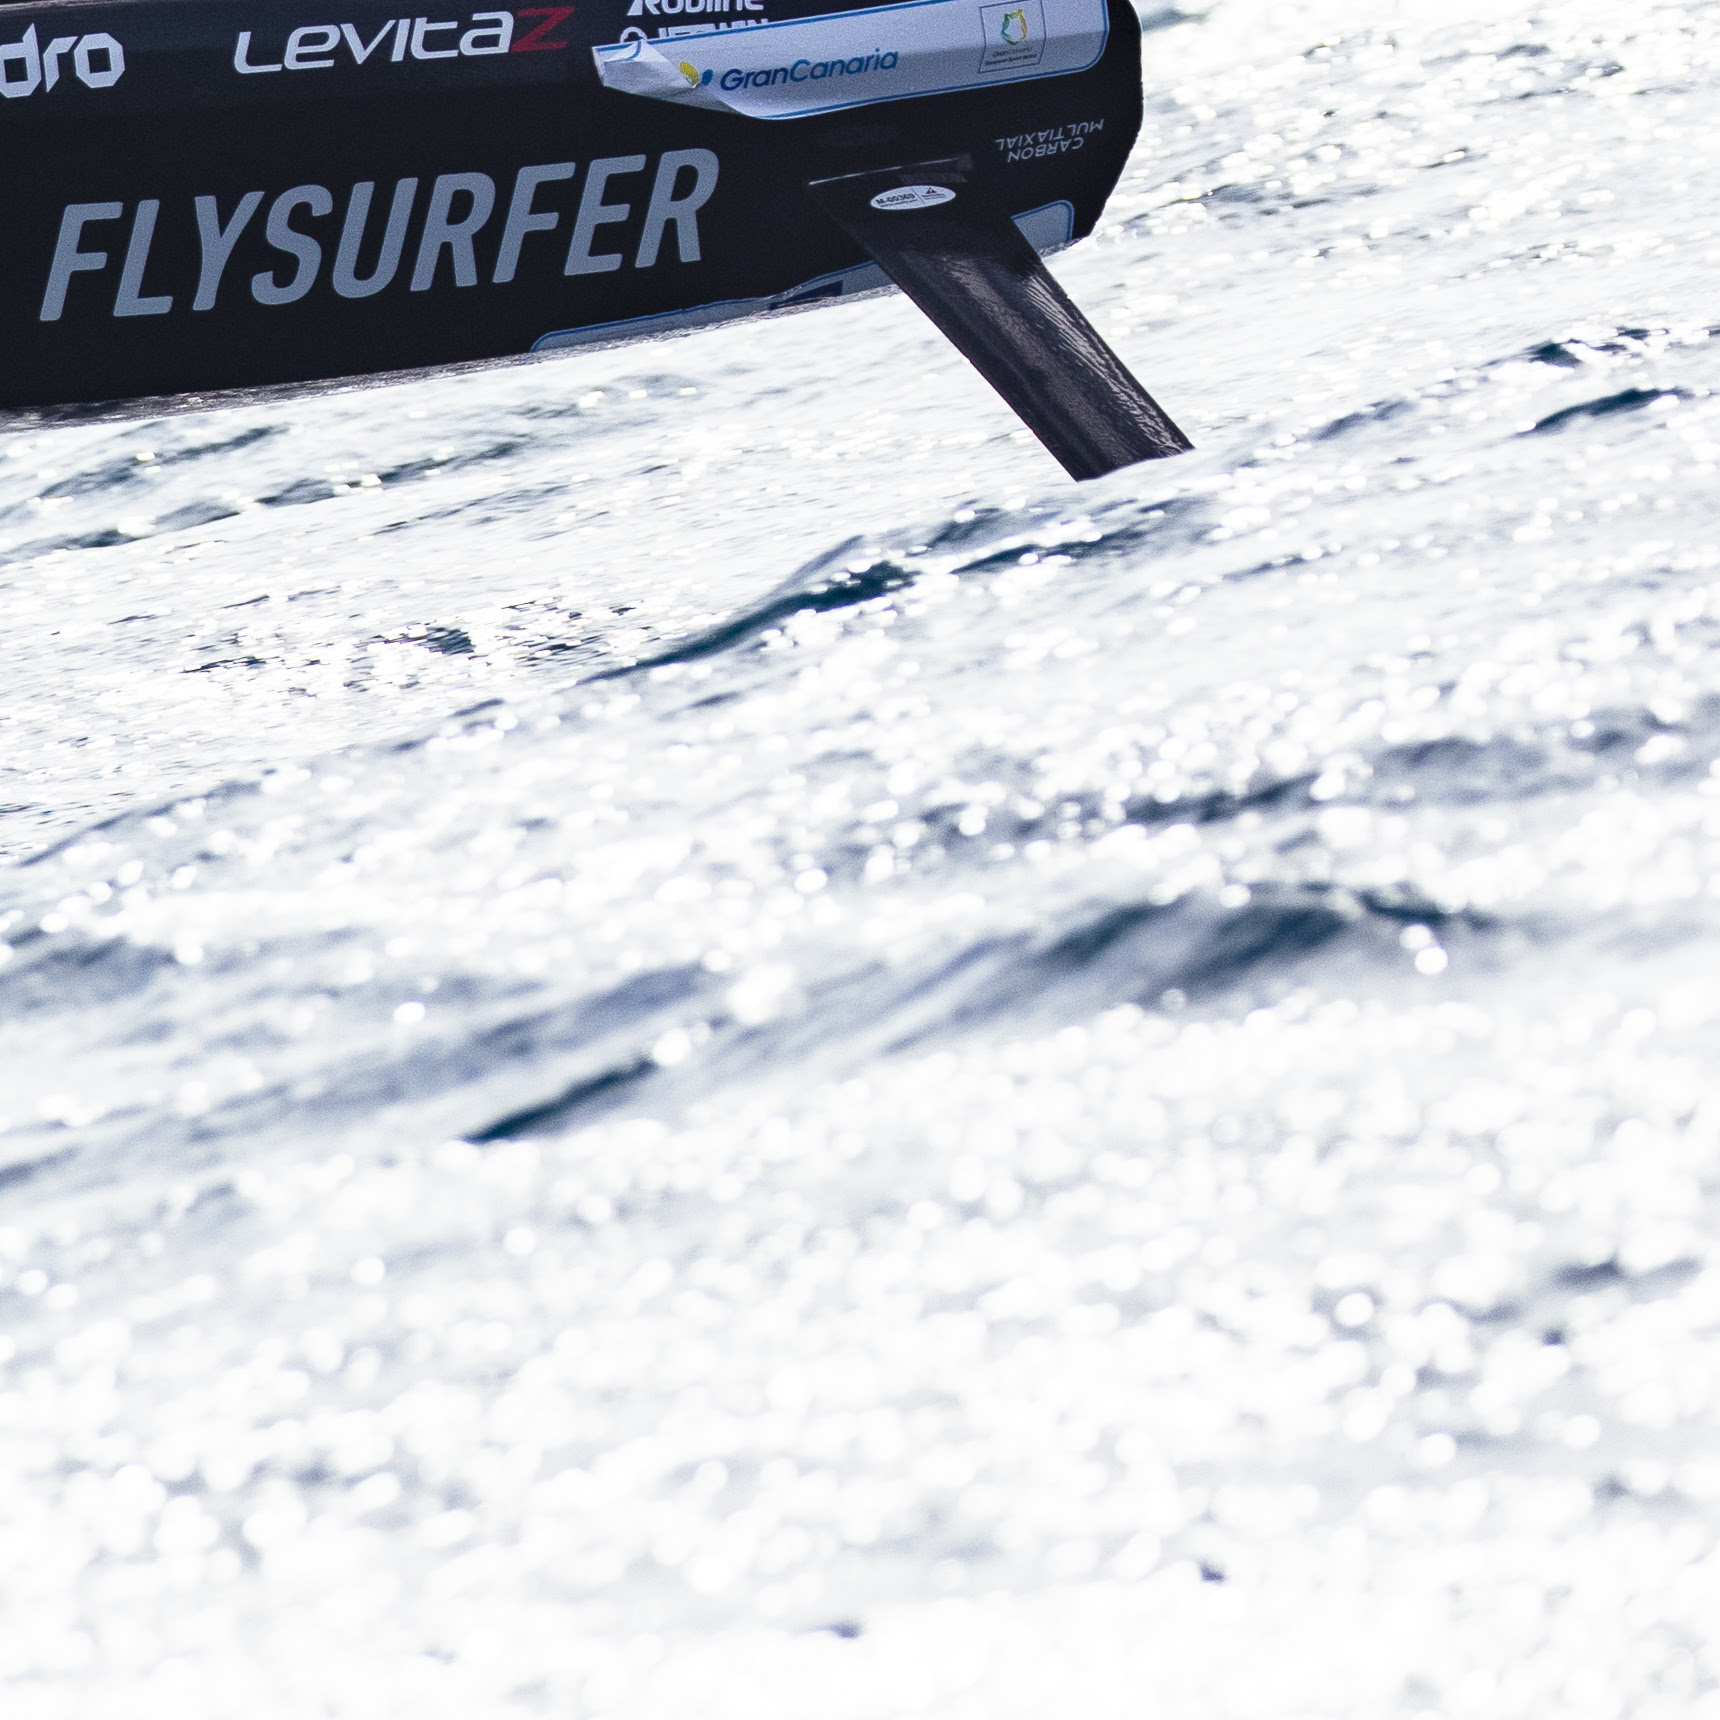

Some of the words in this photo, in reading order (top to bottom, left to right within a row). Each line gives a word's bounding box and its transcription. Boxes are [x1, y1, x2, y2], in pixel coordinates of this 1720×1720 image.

[720, 47, 899, 91] GranCanaria
[995, 118, 1104, 151] MULTIAXIAL
[1007, 137, 1084, 163] CARBON
[40, 148, 720, 321] FLYSURFER
